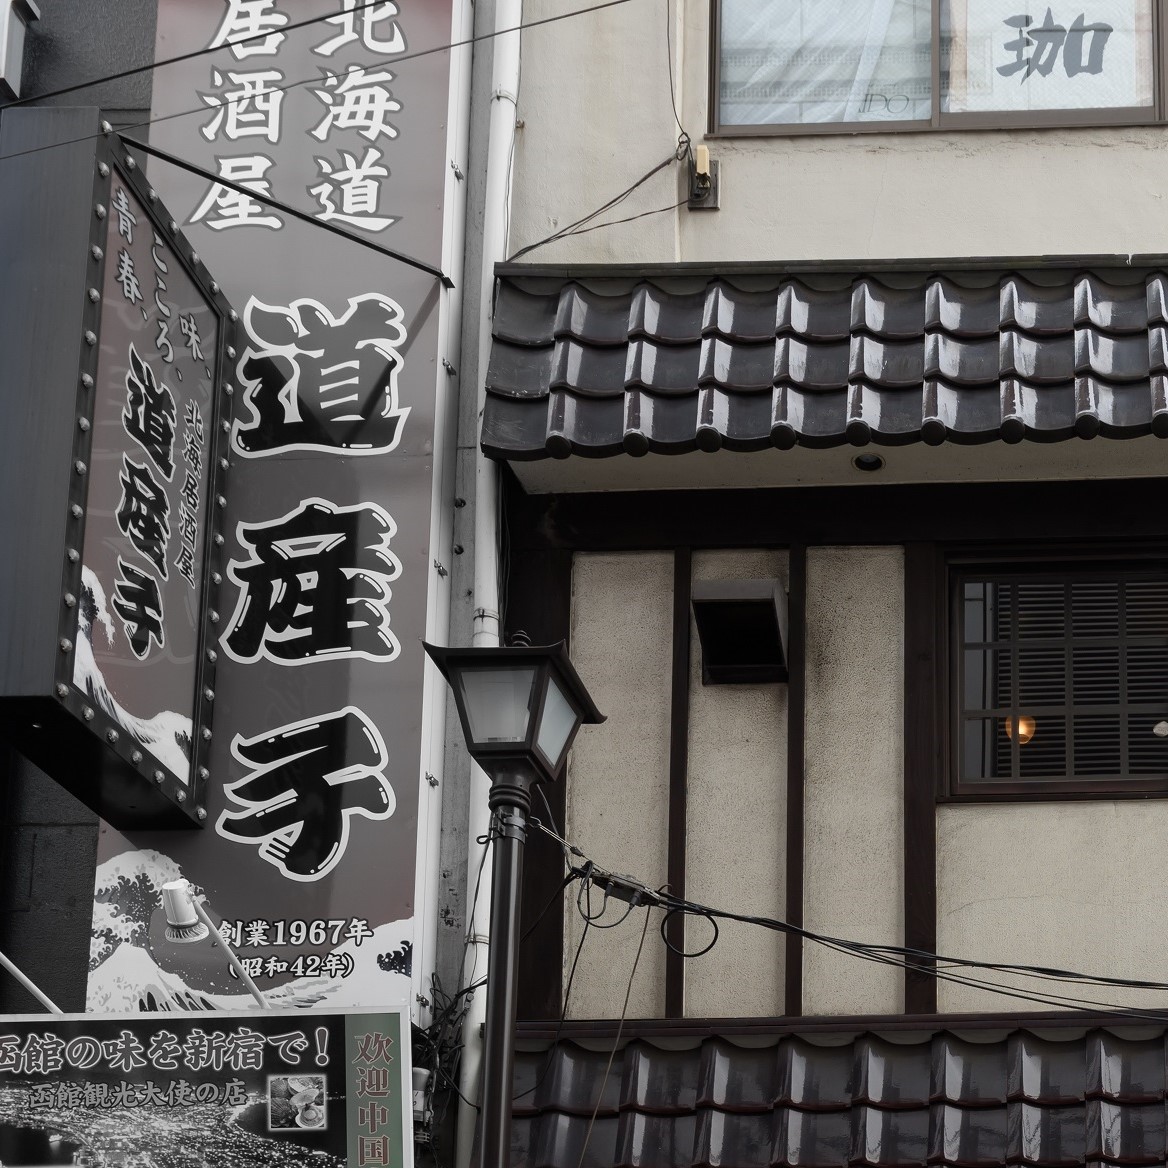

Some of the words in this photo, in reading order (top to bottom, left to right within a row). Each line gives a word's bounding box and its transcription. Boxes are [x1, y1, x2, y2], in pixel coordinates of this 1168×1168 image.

[187, 0, 288, 230] 居酒屋
[309, 0, 407, 232] 北海道
[111, 342, 177, 661] 道産子
[216, 293, 410, 882] 道産子
[217, 917, 374, 946] 創業1967年
[229, 952, 355, 978] (昭和42年)
[29, 1078, 249, 1109] 函館観光大使の店
